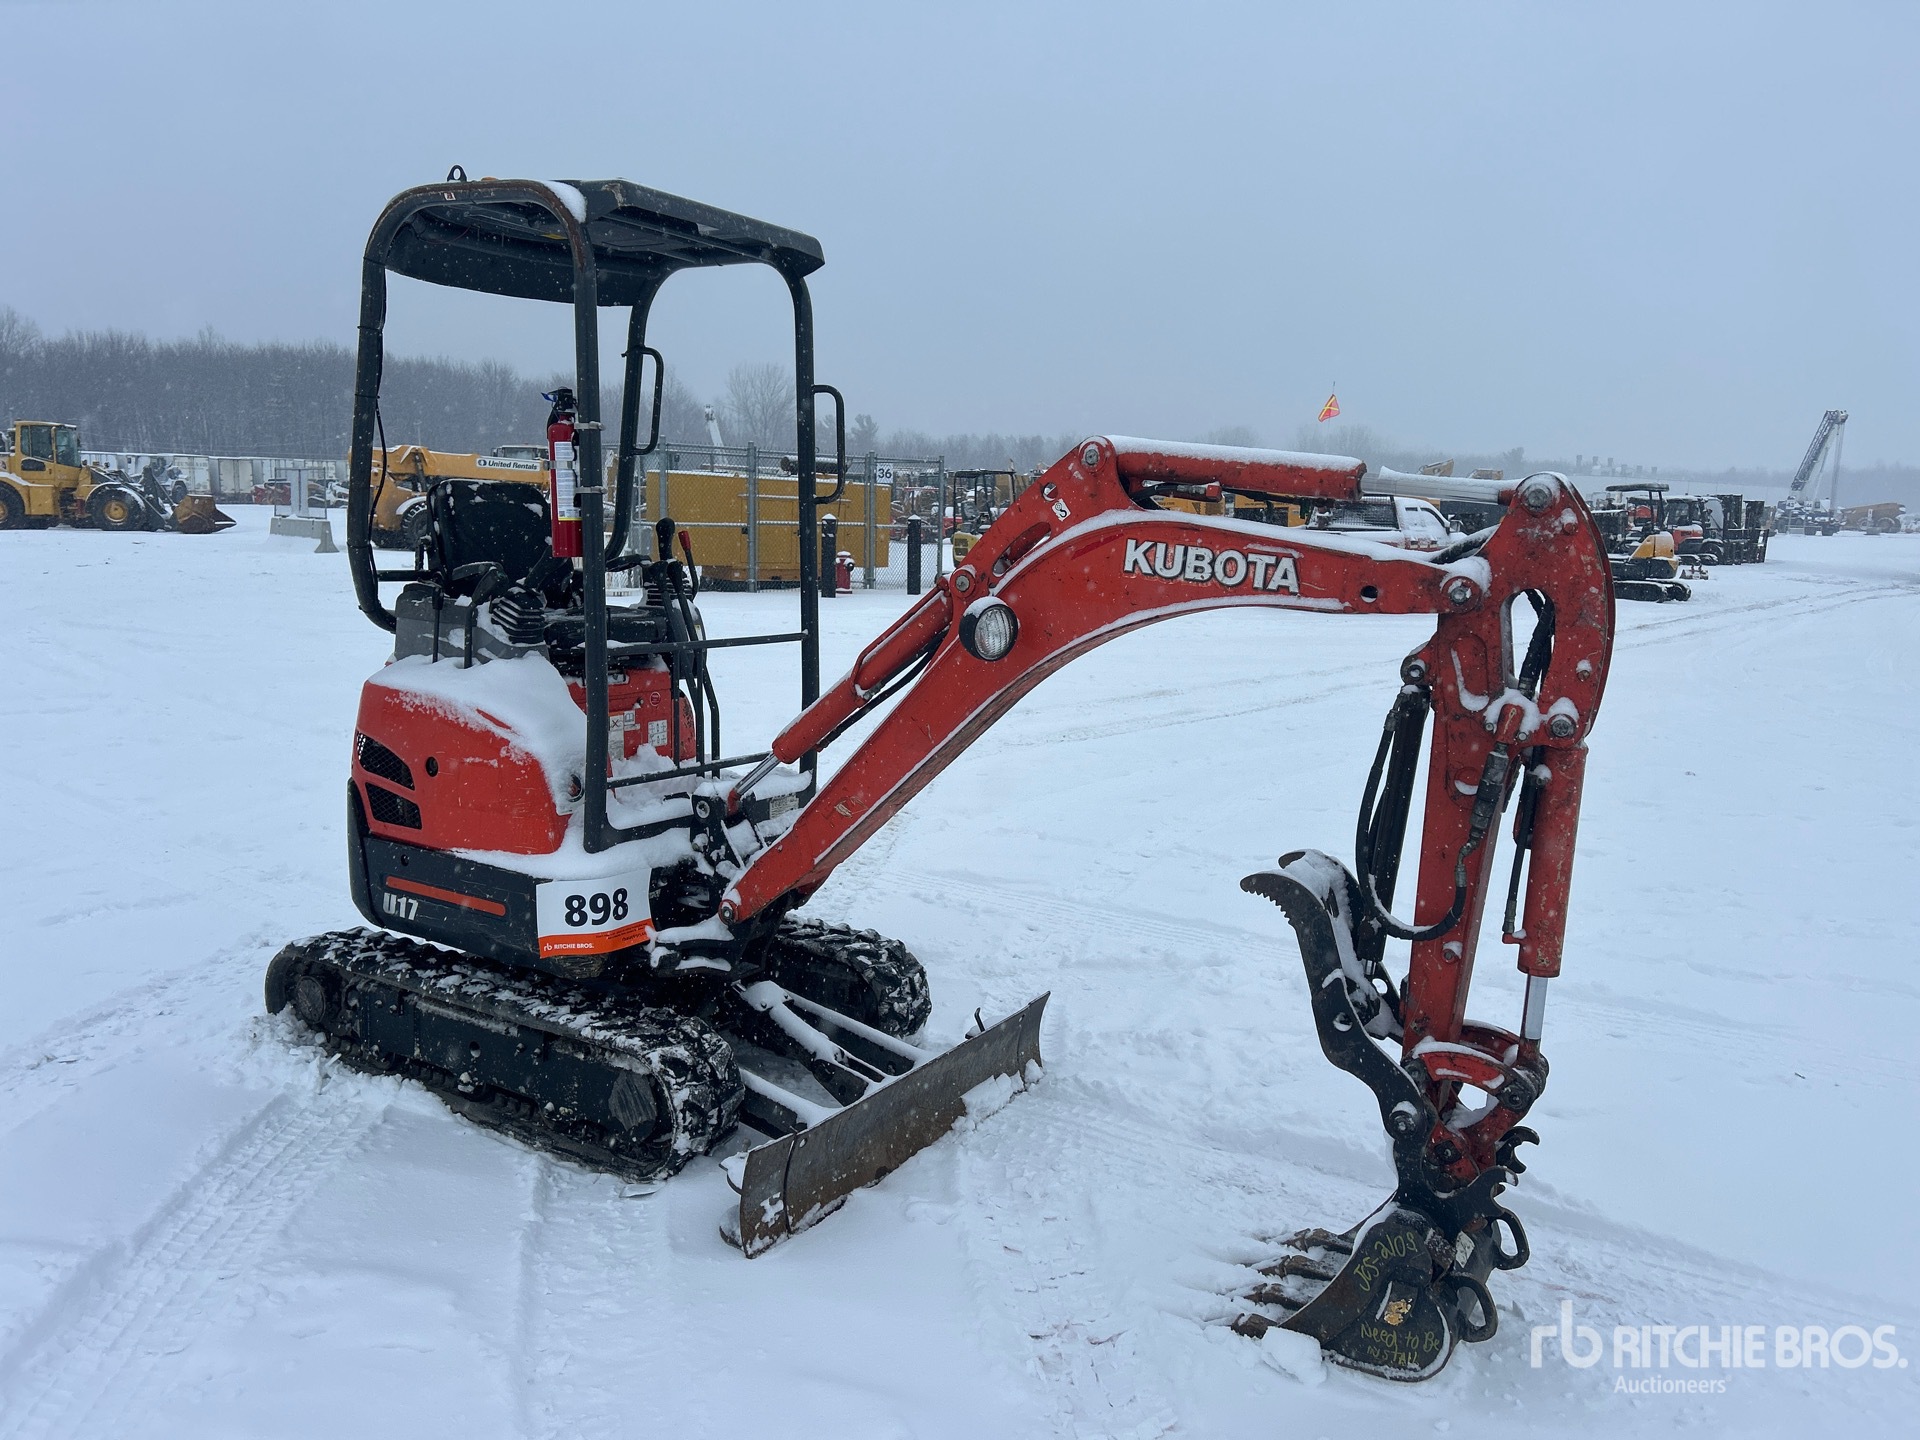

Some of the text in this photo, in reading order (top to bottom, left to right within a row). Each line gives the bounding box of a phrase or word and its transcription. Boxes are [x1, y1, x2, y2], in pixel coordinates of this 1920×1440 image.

[488, 460, 538, 470] United Rentals
[878, 468, 892, 479] 36
[1123, 538, 1300, 595] KUBOTA
[382, 892, 419, 921] U17
[564, 887, 629, 927] 898
[543, 942, 553, 952] rb
[1360, 1321, 1440, 1353] Need to Be
